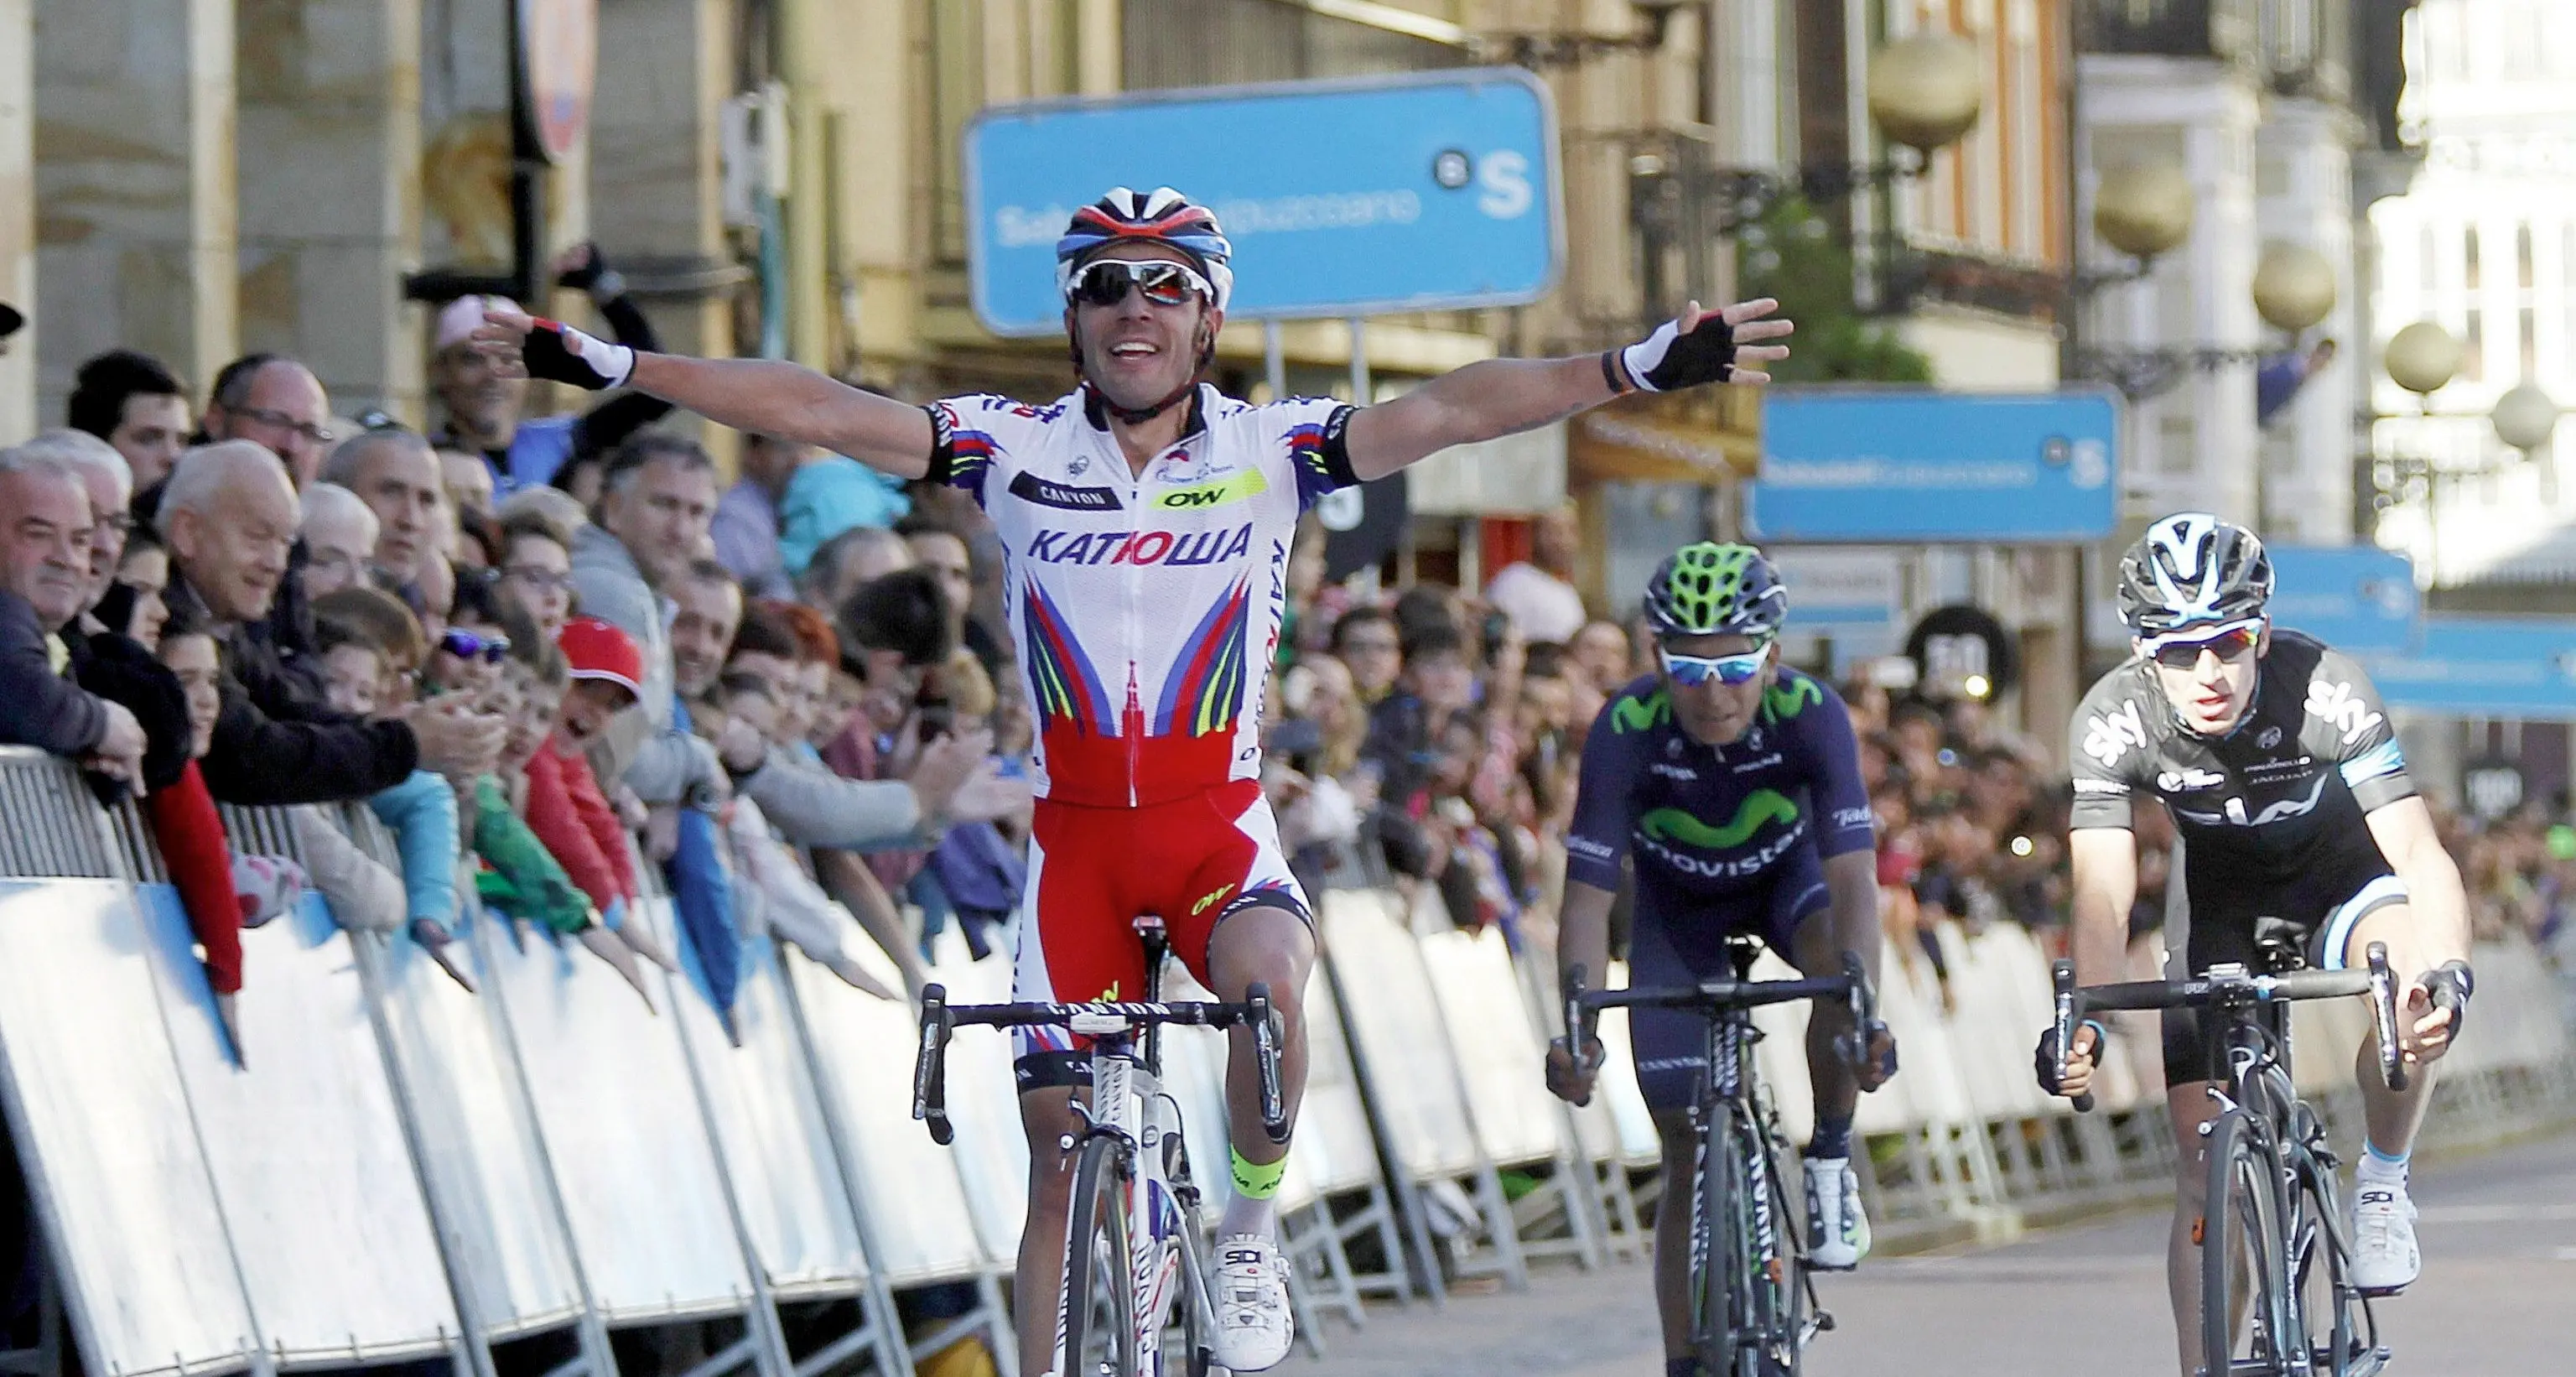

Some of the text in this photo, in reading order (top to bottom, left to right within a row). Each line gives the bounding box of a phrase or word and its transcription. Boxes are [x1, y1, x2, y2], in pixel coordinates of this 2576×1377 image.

[1479, 149, 1532, 218] S
[1040, 485, 1106, 505] CANYON
[1164, 488, 1226, 507] OW
[1633, 818, 1806, 877] movistar
[1192, 883, 1235, 916] OW
[1047, 1002, 1171, 1015] CANYON
[1138, 1244, 1153, 1354] CANYON
